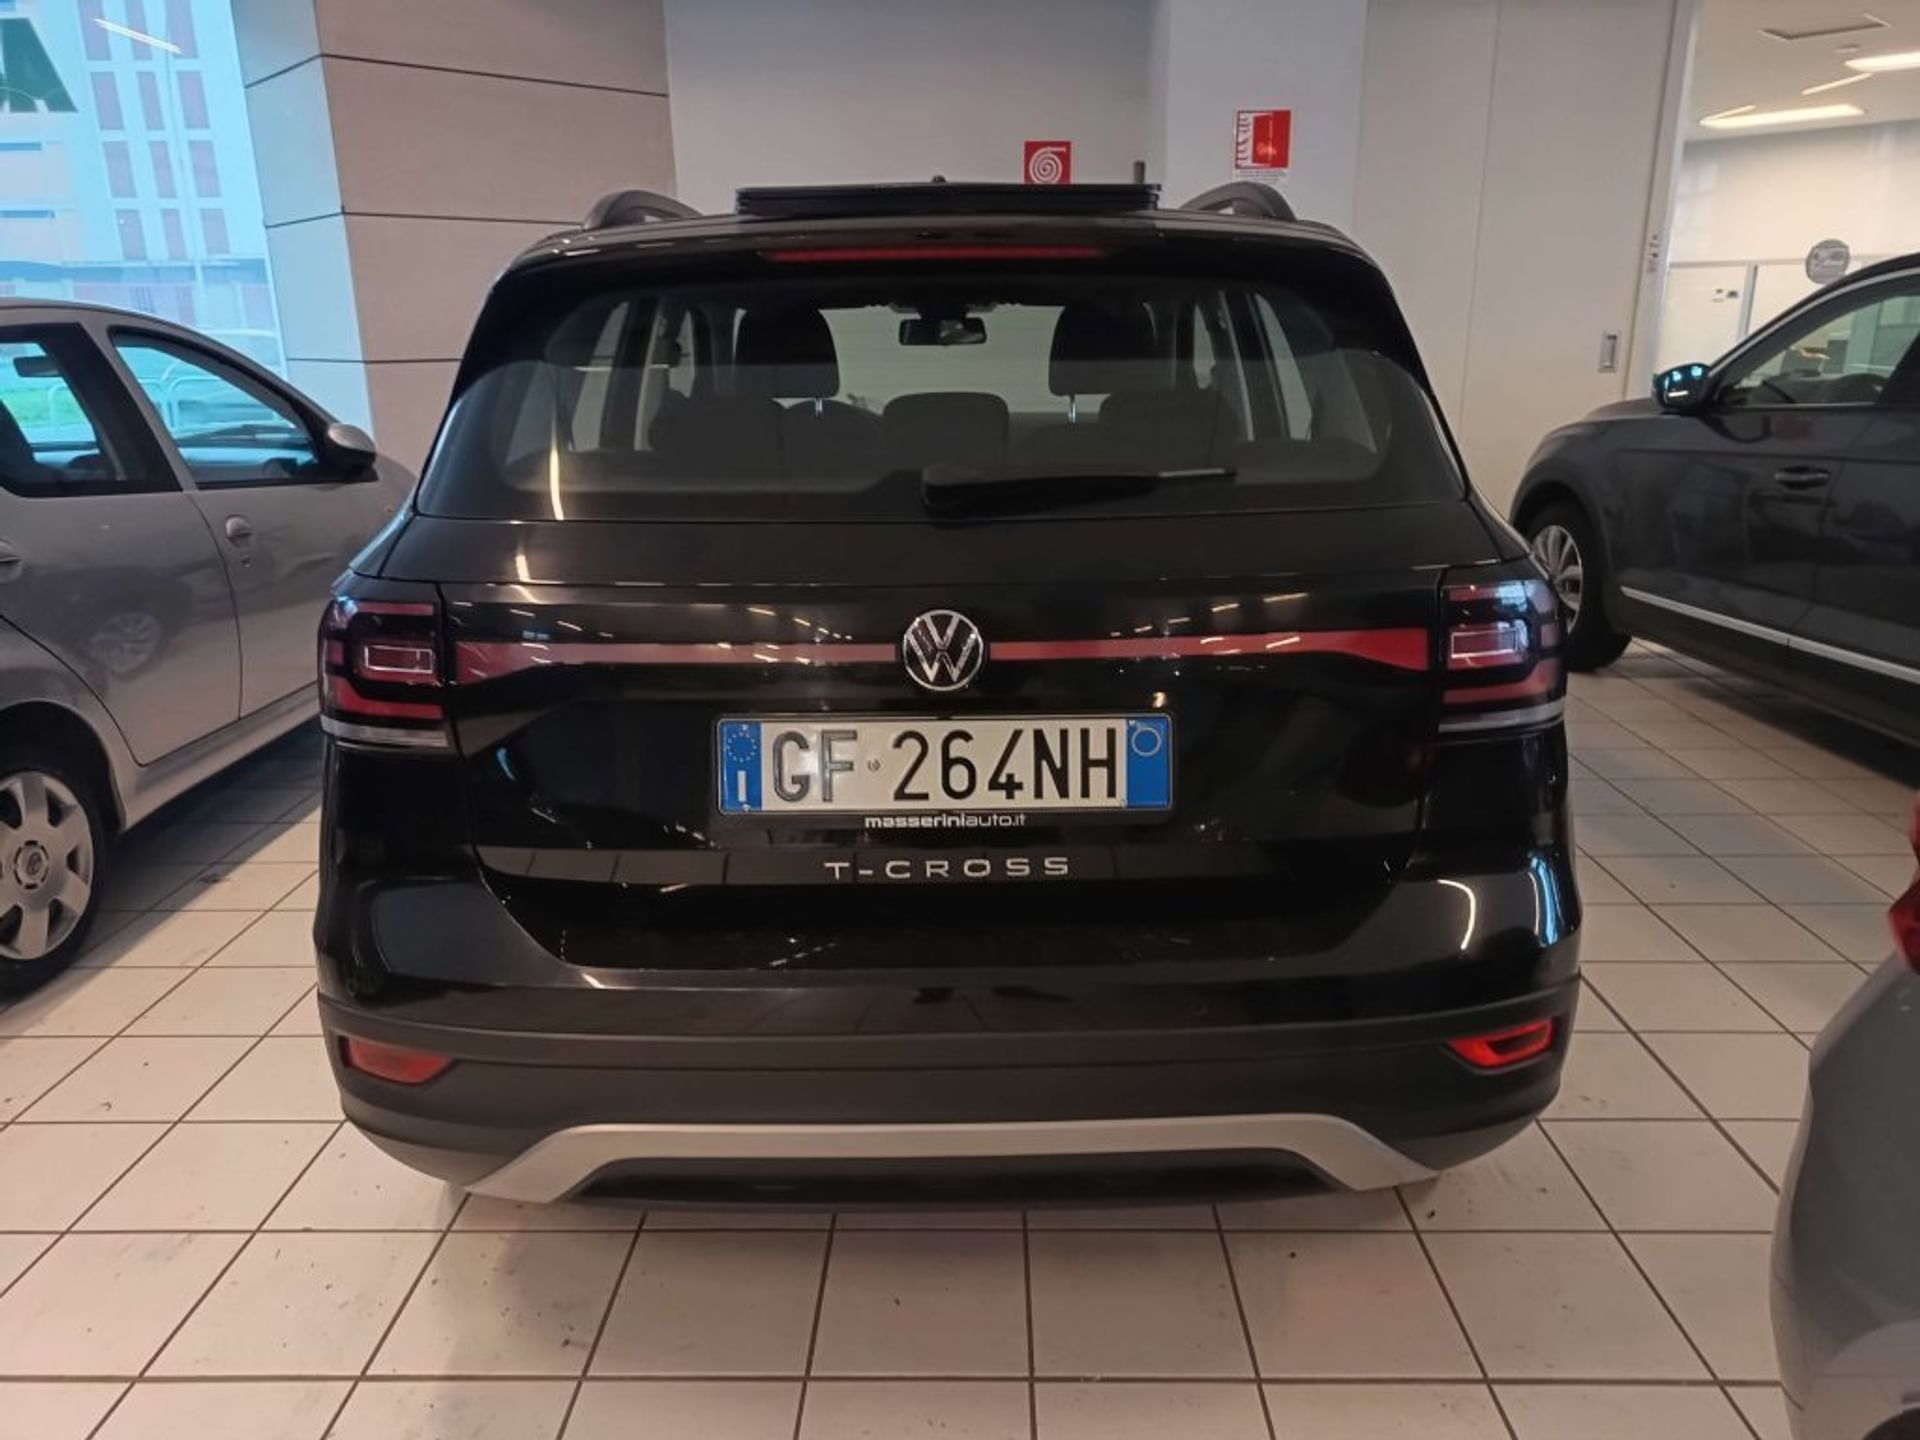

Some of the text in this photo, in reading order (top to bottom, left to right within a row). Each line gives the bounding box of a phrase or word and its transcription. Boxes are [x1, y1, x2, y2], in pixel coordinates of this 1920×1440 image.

[905, 611, 981, 688] VW
[773, 729, 858, 802] GF
[892, 728, 1117, 801] 264NH
[865, 812, 1027, 829] masseriniauto.it
[824, 856, 1069, 881] T-CROSS
